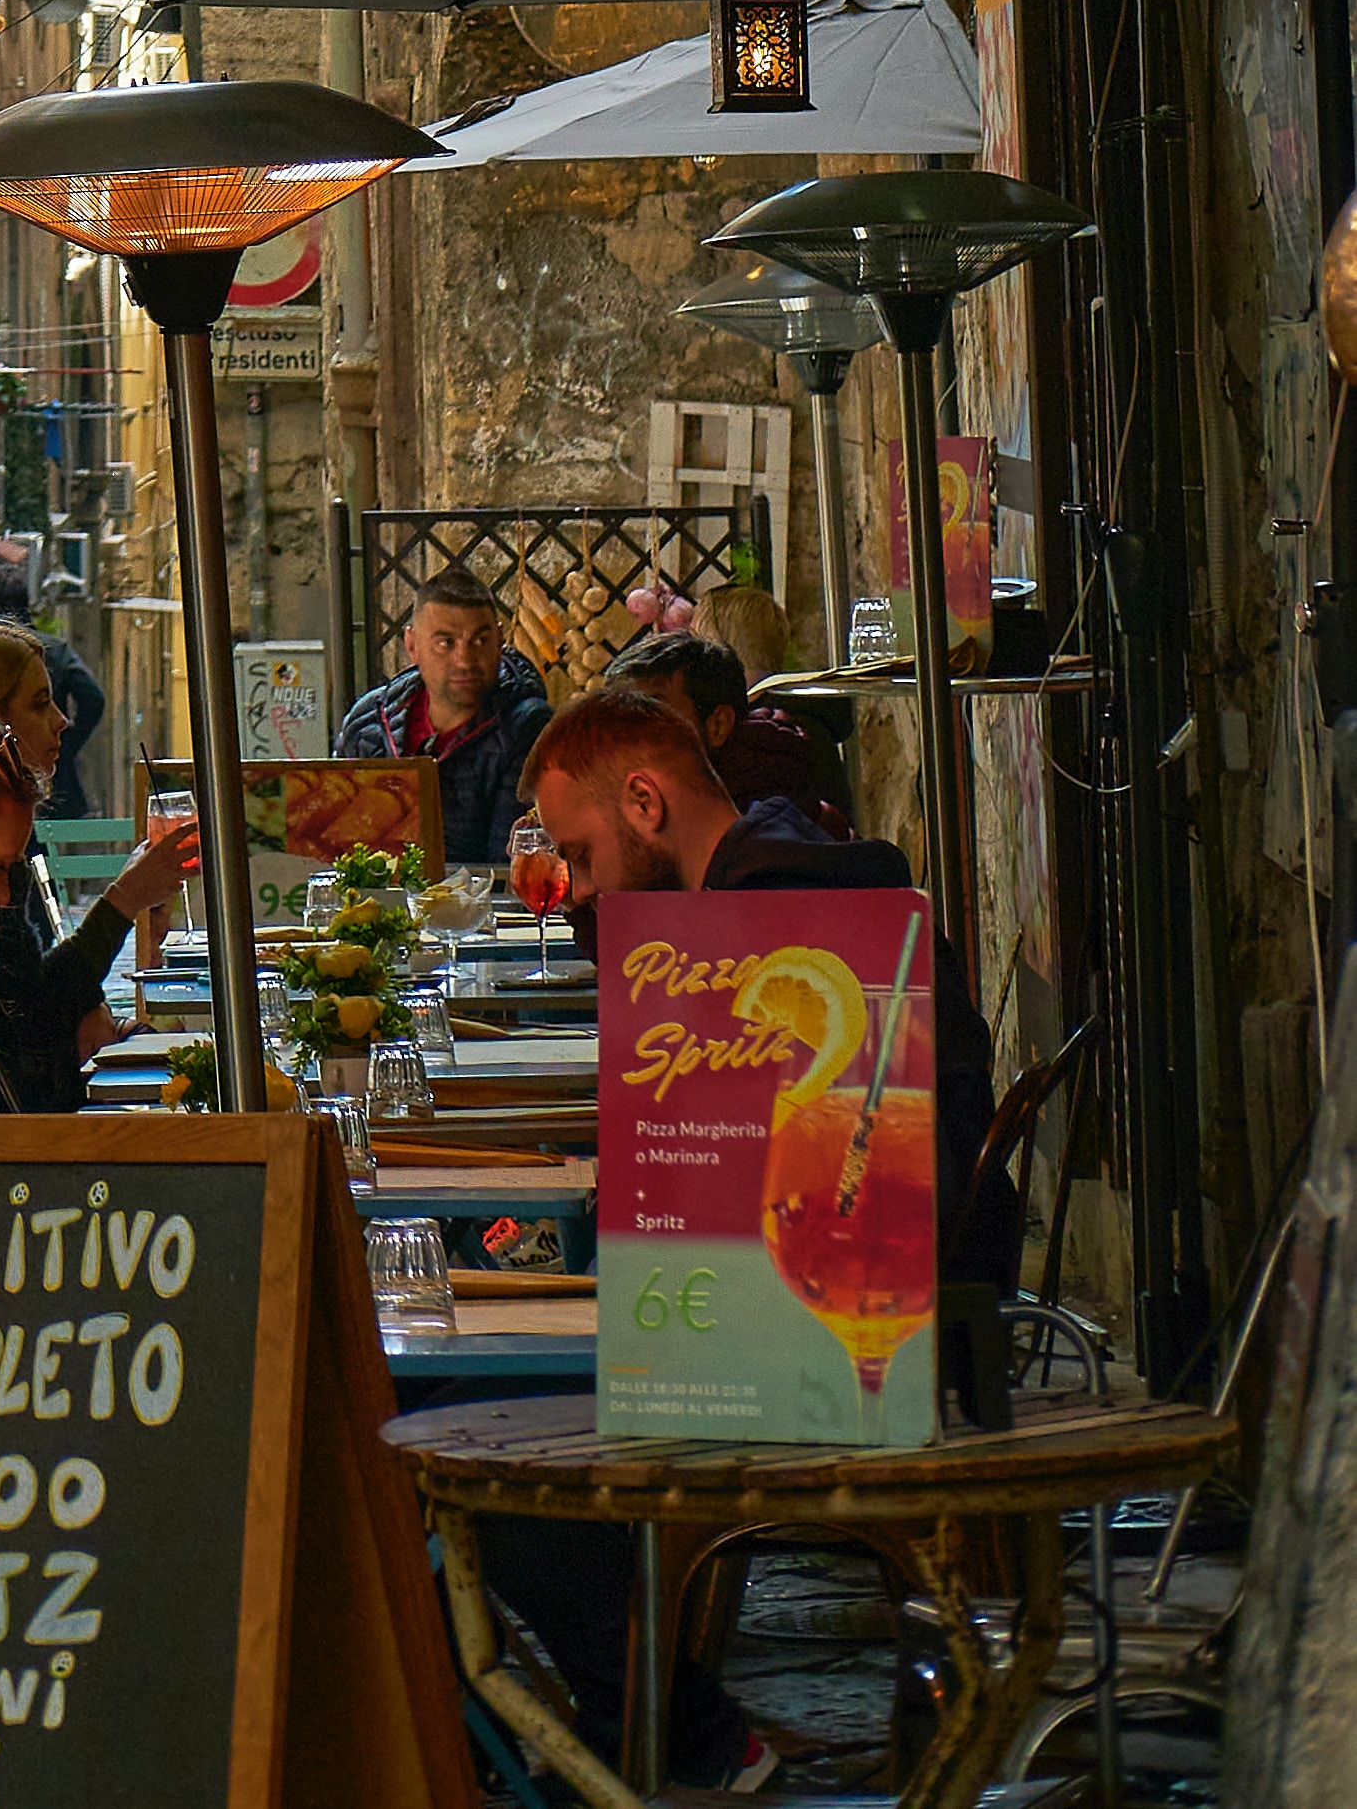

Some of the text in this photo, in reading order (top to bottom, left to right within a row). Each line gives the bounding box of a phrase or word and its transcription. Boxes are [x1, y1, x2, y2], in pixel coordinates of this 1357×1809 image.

[219, 350, 316, 369] residenti
[258, 882, 307, 917] 9€
[622, 941, 760, 1004] Pizza
[621, 1021, 794, 1103] Spritz
[636, 1120, 766, 1140] Pizza Margherita
[636, 1149, 720, 1165] o Marinara
[635, 1213, 685, 1232] Spritz
[634, 1267, 718, 1333] 6€
